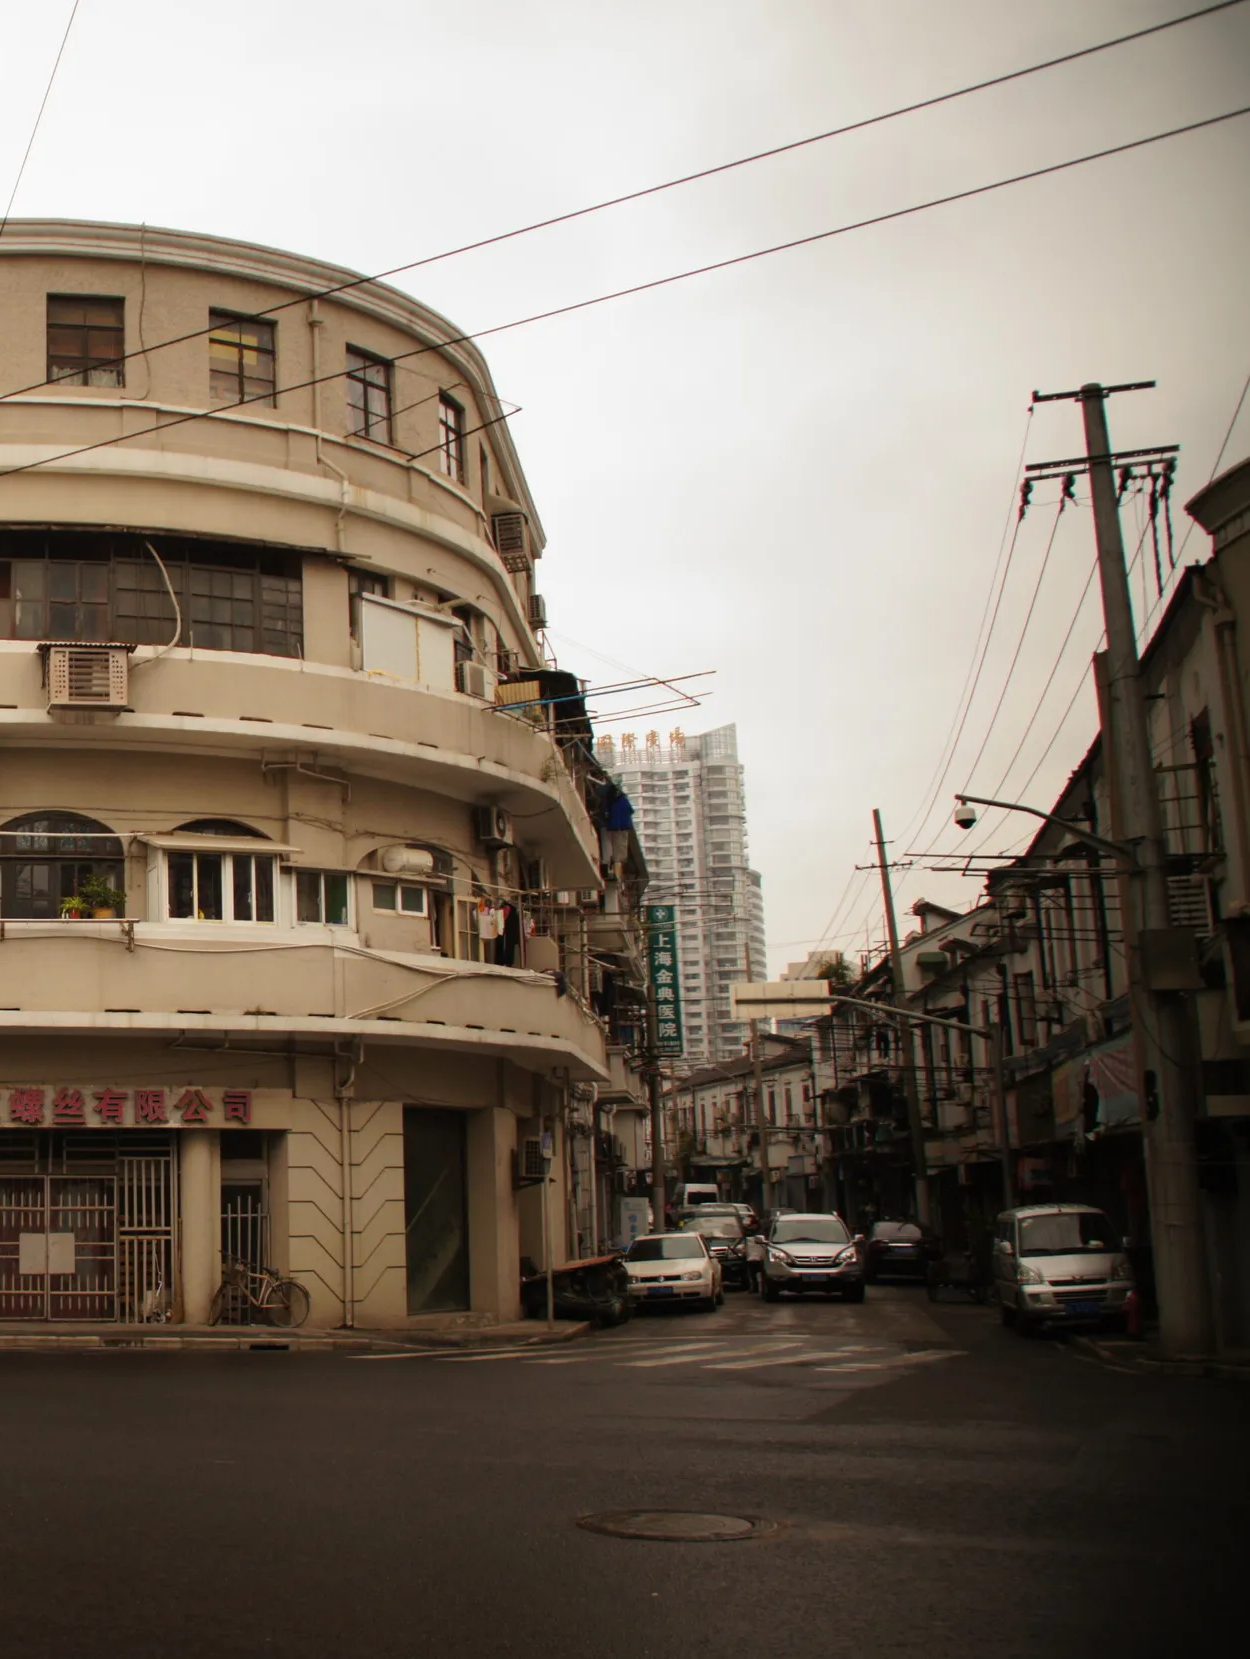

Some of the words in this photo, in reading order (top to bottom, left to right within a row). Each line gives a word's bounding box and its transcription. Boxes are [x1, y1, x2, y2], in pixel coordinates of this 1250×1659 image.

[653, 934, 678, 1039] 上海金典医院
